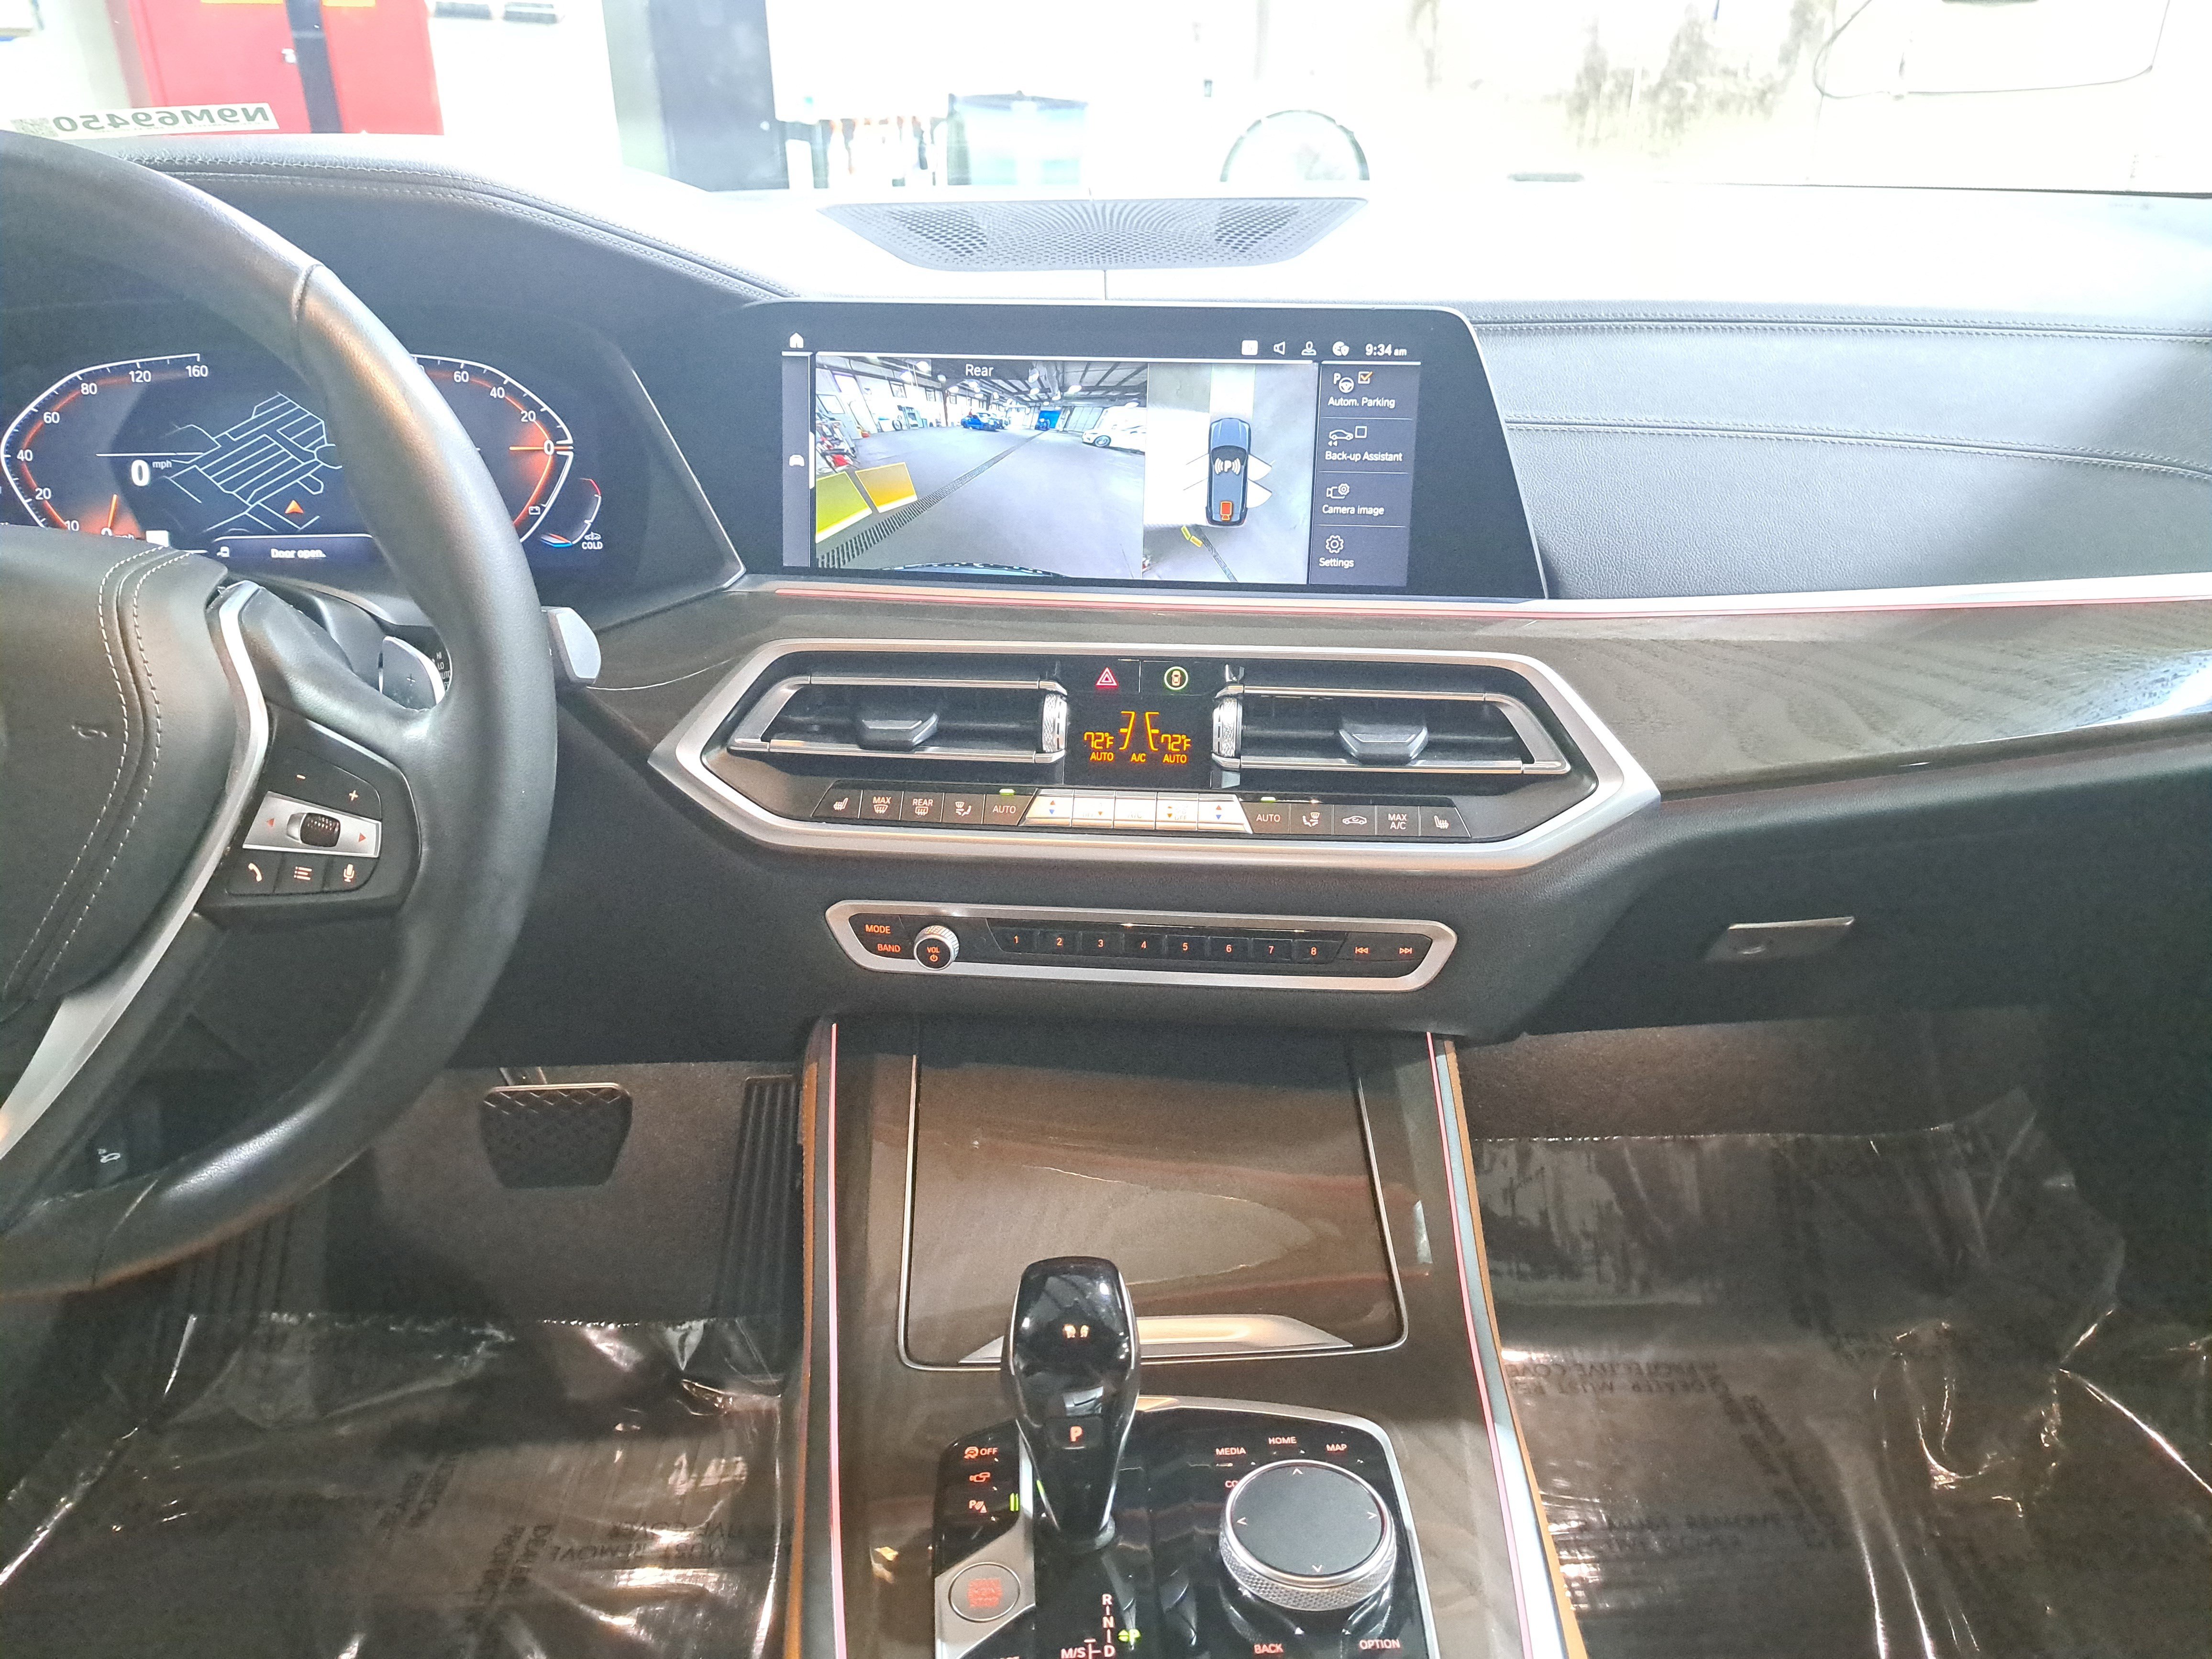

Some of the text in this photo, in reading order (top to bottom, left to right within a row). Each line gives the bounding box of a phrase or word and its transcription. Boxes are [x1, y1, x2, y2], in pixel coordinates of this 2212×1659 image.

[1366, 343, 1392, 356] 9:34
[129, 370, 151, 382] 120
[186, 365, 208, 377] 160
[965, 364, 994, 377] Rear
[453, 370, 469, 383] 60
[81, 383, 97, 395] 80
[490, 387, 505, 398] 40
[1327, 396, 1395, 409] Autom. Parking
[44, 411, 60, 423] 60
[520, 410, 536, 422] 20
[543, 440, 554, 455] 0
[17, 449, 33, 462] 40
[1325, 451, 1403, 462] Back-up Assistant
[131, 459, 172, 487] 0 mph
[35, 487, 51, 500] 20
[1322, 504, 1355, 514] Camera
[66, 520, 79, 531] 10
[582, 541, 603, 550] COLD
[271, 548, 296, 559] Door
[1319, 557, 1354, 569] Settings
[1090, 752, 1114, 761] AUTO
[1130, 753, 1146, 762] A/C
[1162, 754, 1187, 763] AUTO
[993, 805, 1016, 814] AUTO
[1256, 814, 1280, 822] AUTO
[1388, 813, 1407, 821] MAX
[1390, 821, 1406, 830] A/C
[865, 924, 891, 934] MODE
[877, 943, 901, 952] BAND
[1057, 937, 1063, 946] 2
[1098, 939, 1104, 948] 3
[1141, 940, 1147, 949] 4
[1183, 942, 1188, 951] 5
[1226, 944, 1232, 952] 6
[1269, 946, 1274, 954] 7
[1311, 947, 1316, 955] 8
[1070, 1426, 1083, 1441] P
[1268, 1436, 1297, 1445] HOME
[1216, 1447, 1246, 1456] MEDIA
[1326, 1444, 1347, 1452] MAP
[1102, 1593, 1112, 1604] R
[1102, 1616, 1114, 1628] N
[1254, 1644, 1283, 1654] BACK
[1359, 1639, 1400, 1649] OPTION
[1061, 1647, 1085, 1659] M/S
[1104, 1645, 1116, 1657] D
